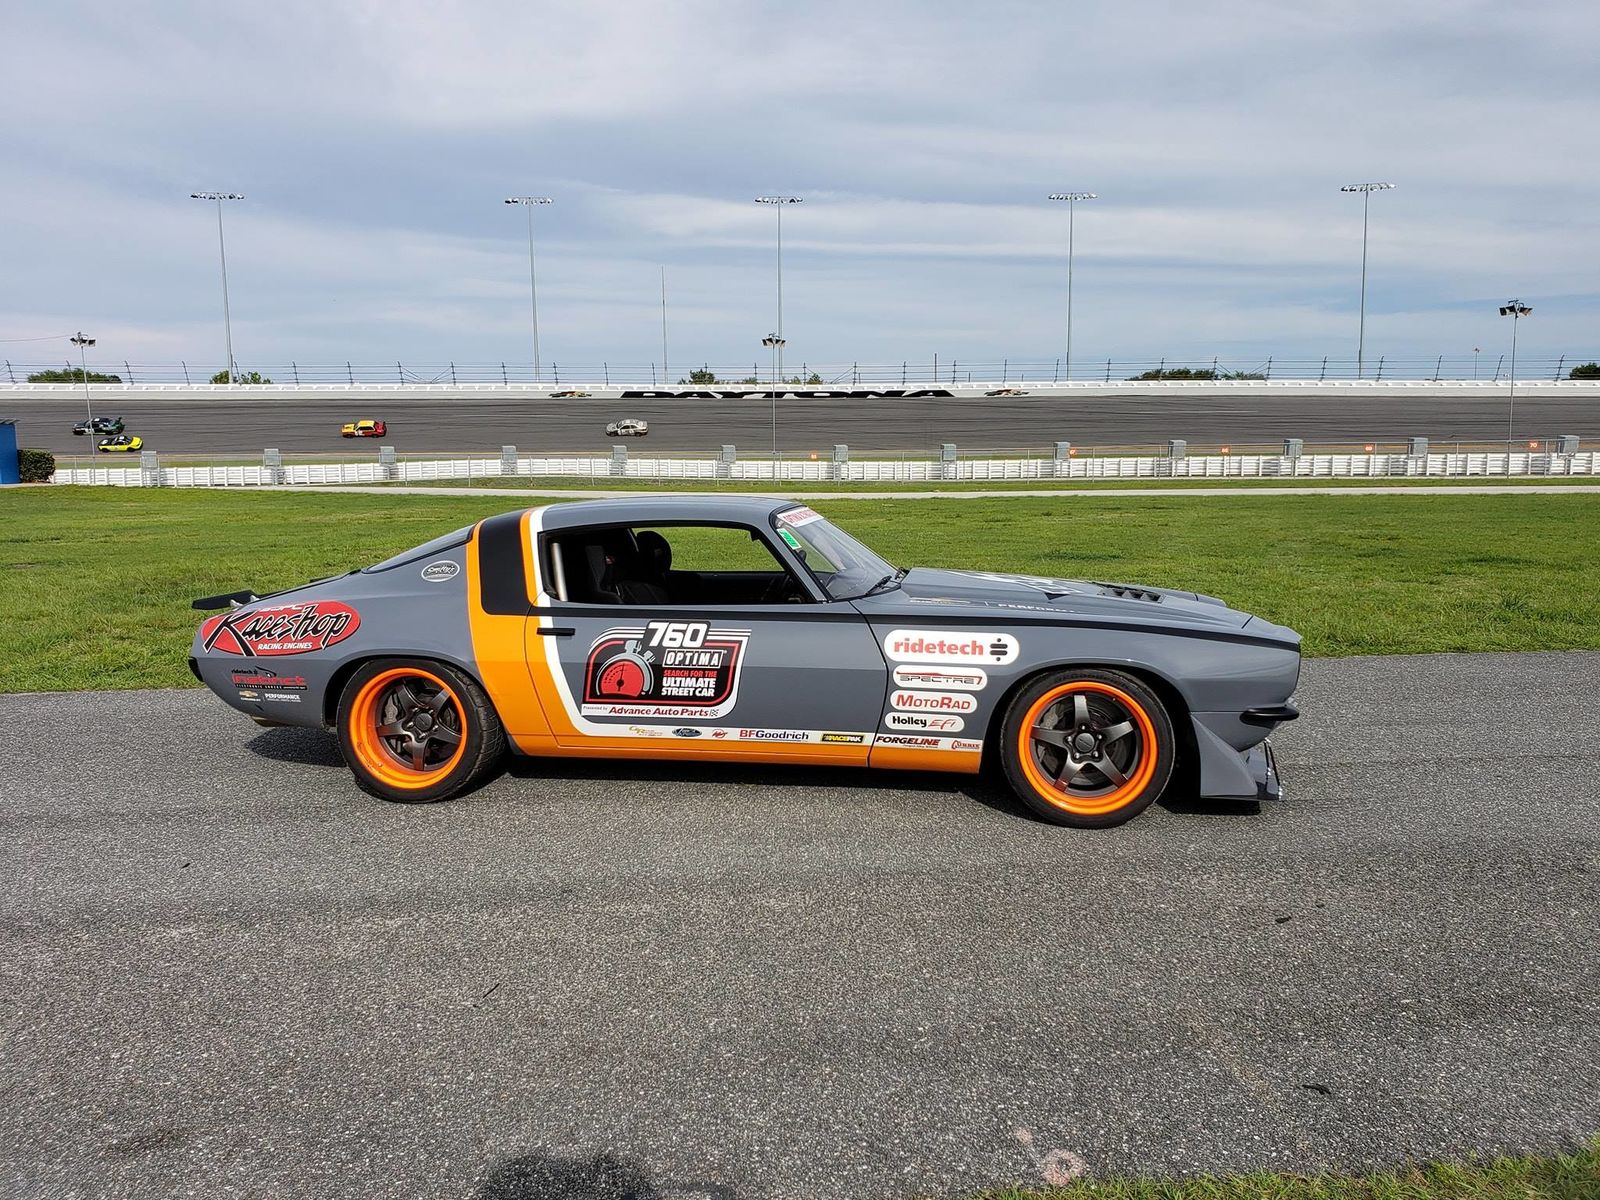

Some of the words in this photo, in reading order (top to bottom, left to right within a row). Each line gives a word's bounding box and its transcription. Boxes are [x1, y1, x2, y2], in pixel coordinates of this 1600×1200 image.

[621, 390, 955, 399] DAYTONA
[648, 622, 708, 648] 760
[283, 641, 312, 650] ENGINES
[893, 637, 984, 655] ridetech
[664, 650, 720, 666] OPTIMA
[664, 669, 689, 678] SEARCH
[690, 670, 703, 678] FOR
[703, 670, 717, 678] THE
[662, 677, 716, 688] ULTIMATE
[661, 687, 695, 697] STREET
[695, 688, 715, 697] CAR
[608, 706, 652, 716] Advance
[652, 707, 680, 716] Auto
[680, 708, 709, 717] Parts
[892, 716, 927, 728] Holley
[739, 730, 809, 740] BFGoodrich
[876, 736, 941, 746] FORGELINE
